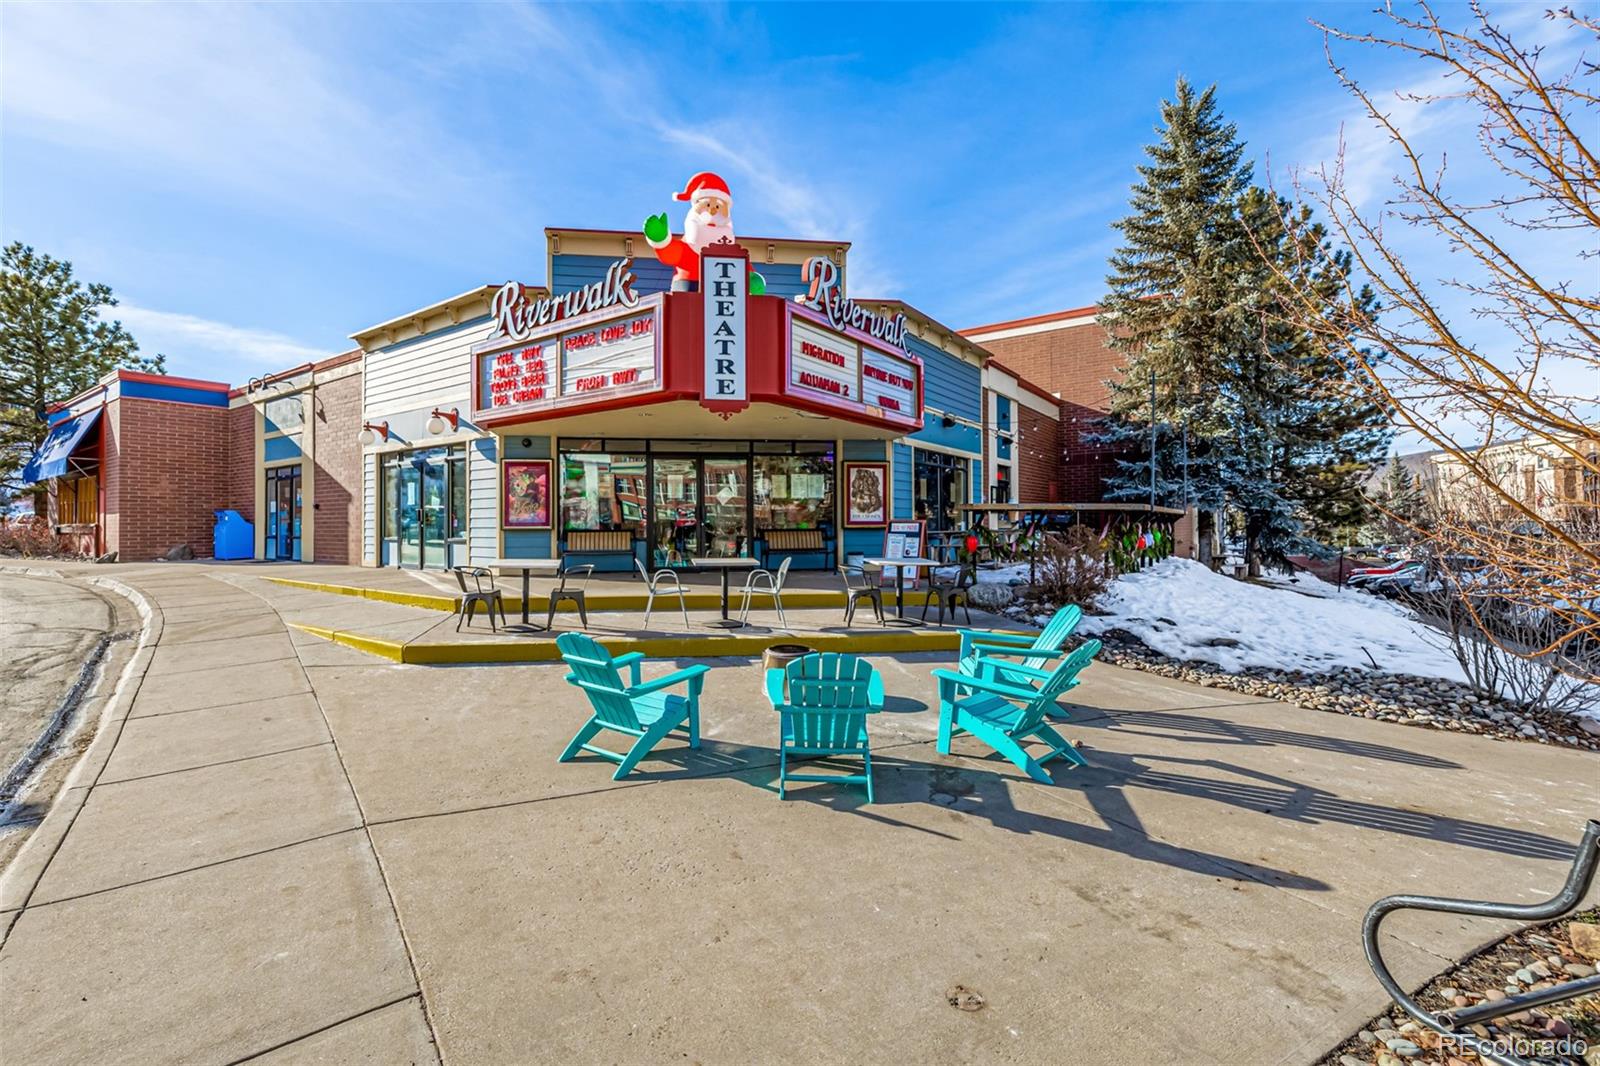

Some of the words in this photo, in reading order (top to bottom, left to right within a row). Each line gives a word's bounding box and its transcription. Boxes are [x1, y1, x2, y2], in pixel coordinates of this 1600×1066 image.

[487, 258, 639, 341] Riverwalk
[803, 256, 914, 359] Riverwalk
[564, 332, 596, 350] PEACE
[600, 324, 626, 342] LOVE
[631, 318, 653, 335] JOY
[713, 262, 736, 395] THEATRE
[802, 341, 845, 368] MIGRATION
[576, 375, 605, 391] FROM
[612, 368, 637, 385] RWT
[799, 371, 841, 394] AQUAMAN
[843, 384, 850, 396] 2
